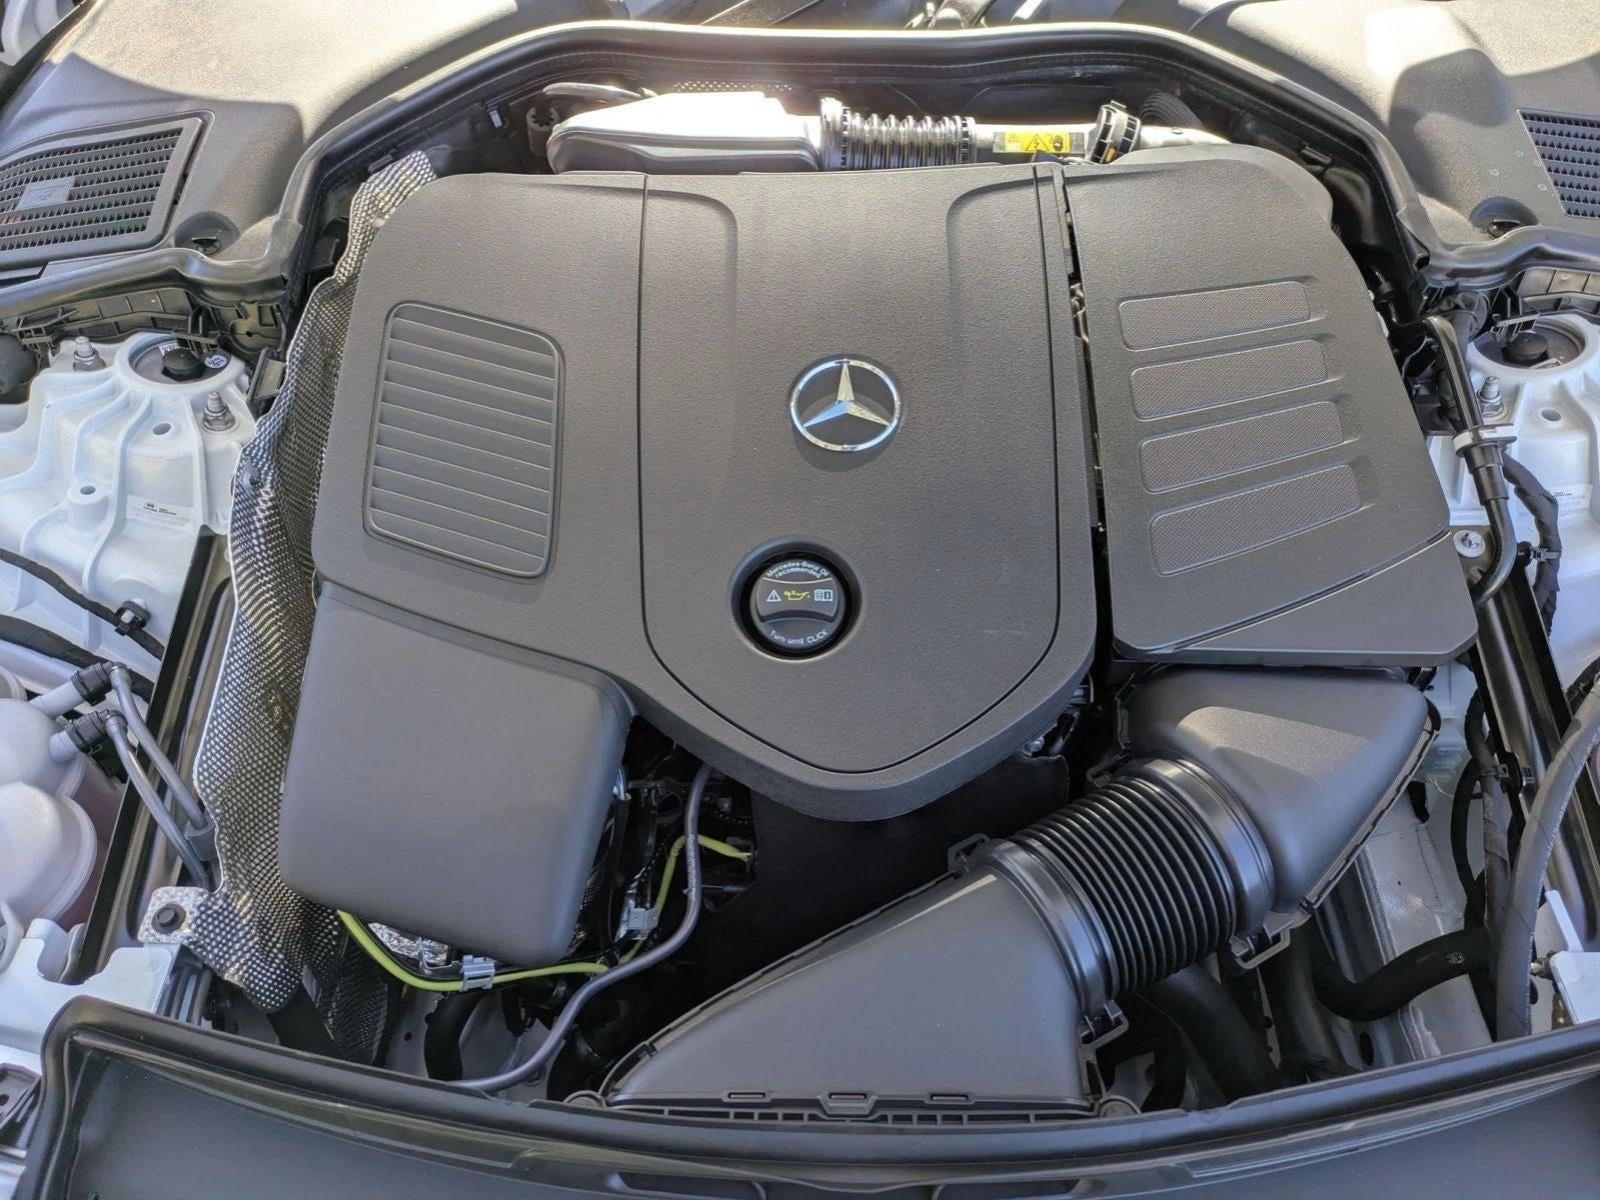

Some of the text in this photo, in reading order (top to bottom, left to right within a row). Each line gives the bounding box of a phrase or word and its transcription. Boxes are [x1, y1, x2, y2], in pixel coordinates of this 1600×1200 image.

[766, 561, 820, 577] Mercedes-Benz
[769, 629, 828, 645] Turn until CLICK
